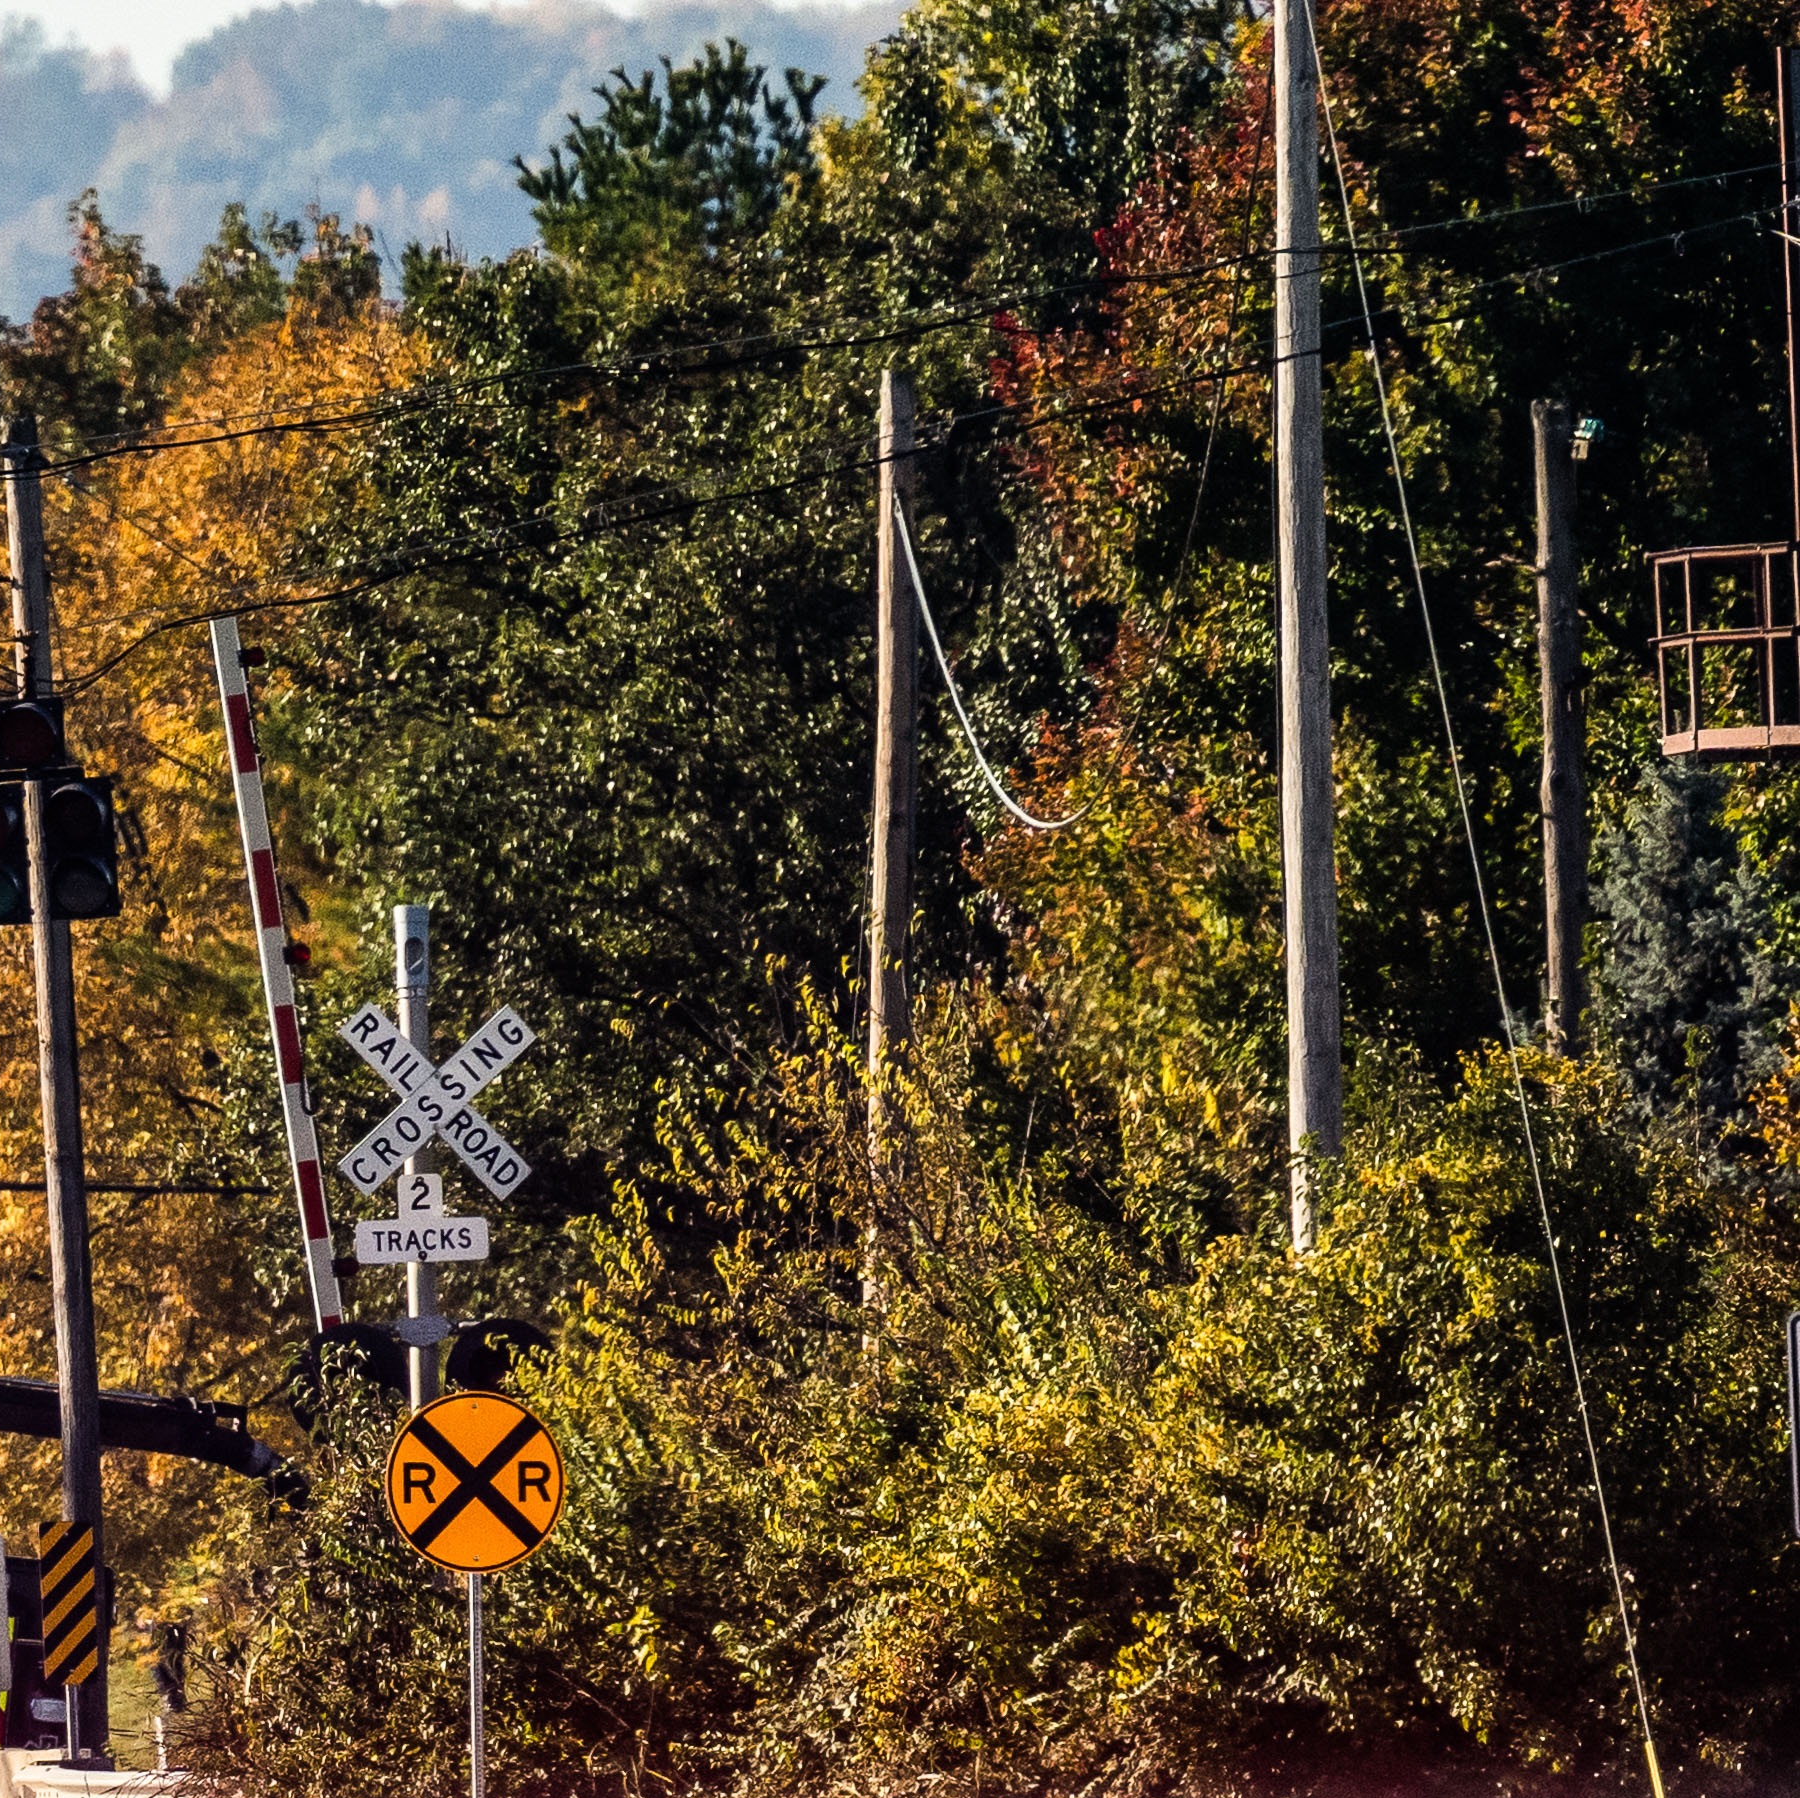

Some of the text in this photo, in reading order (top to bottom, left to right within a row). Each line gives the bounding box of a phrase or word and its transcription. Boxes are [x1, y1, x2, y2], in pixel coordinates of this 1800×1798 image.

[351, 1012, 520, 1186] RAIL ROAD
[352, 1018, 524, 1185] CROSSING
[372, 1227, 472, 1252] TRACKS
[410, 1181, 431, 1211] 2
